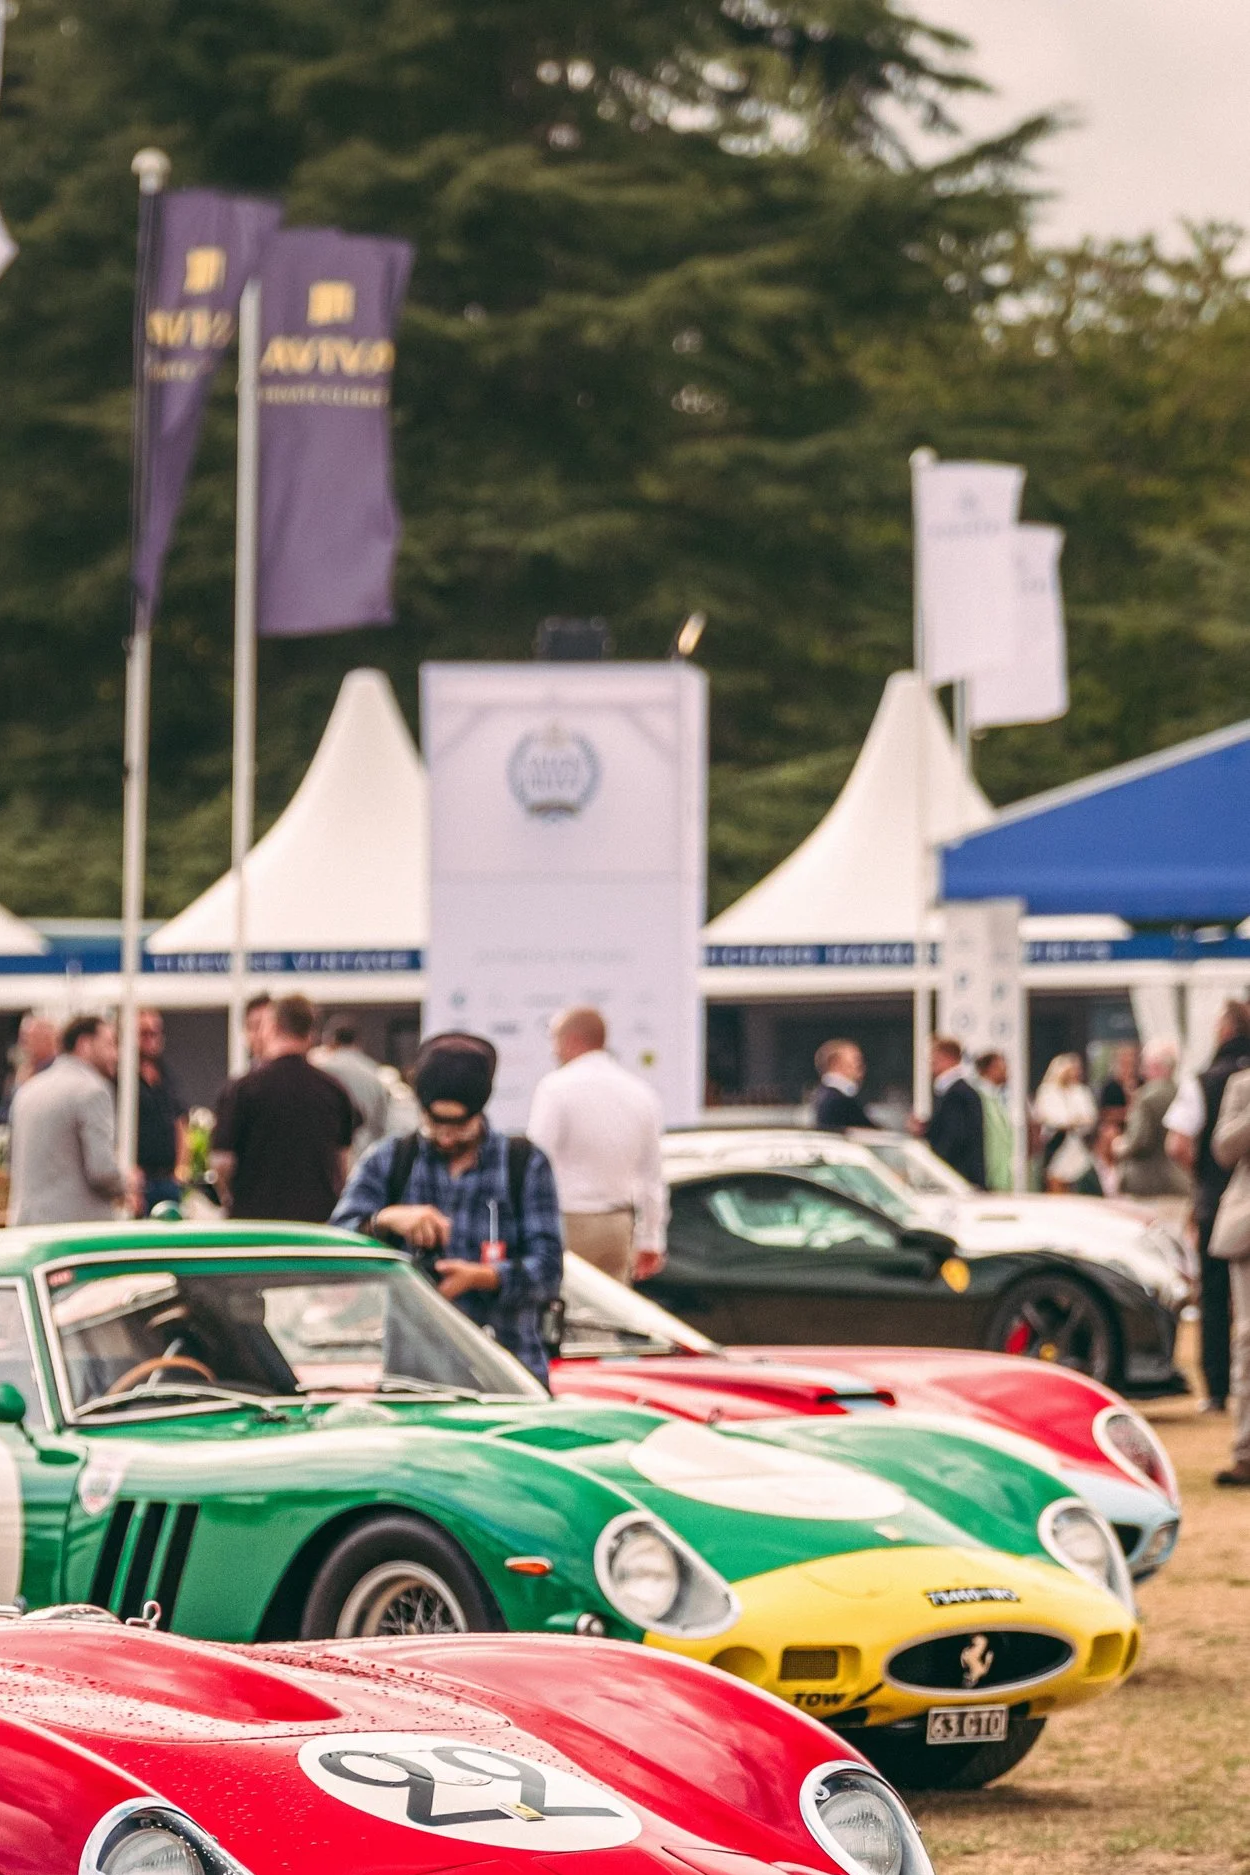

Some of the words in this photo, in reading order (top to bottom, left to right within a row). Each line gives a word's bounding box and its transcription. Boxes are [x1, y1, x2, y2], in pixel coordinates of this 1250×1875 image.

[793, 1693, 847, 1707] TOW
[932, 1715, 959, 1738] 63
[318, 1746, 623, 1826] 22
